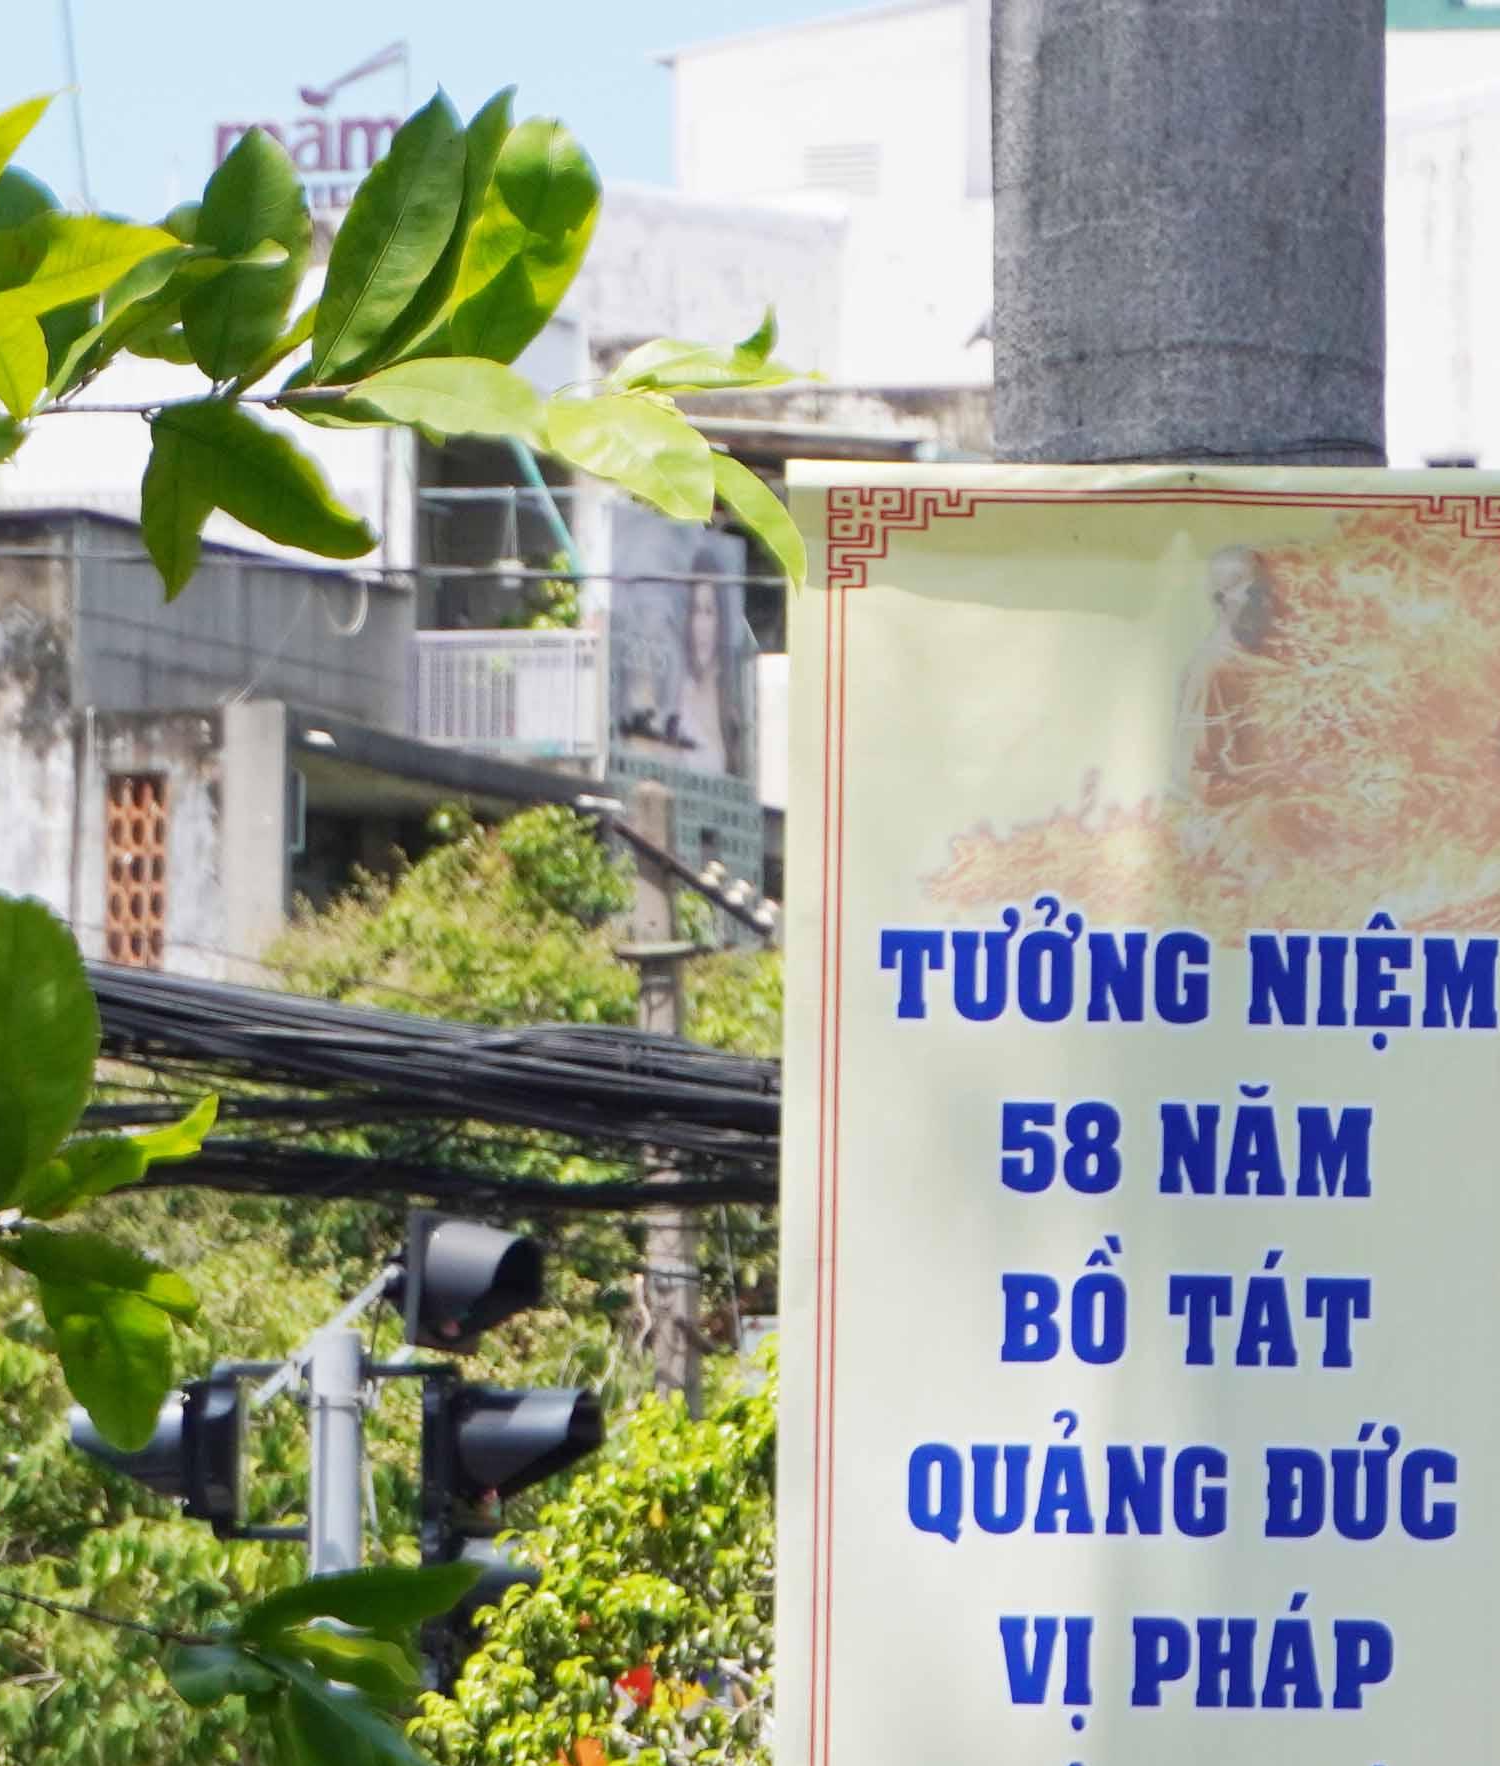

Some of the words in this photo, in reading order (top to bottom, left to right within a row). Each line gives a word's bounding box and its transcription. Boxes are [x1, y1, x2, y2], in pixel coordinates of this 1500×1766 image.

[880, 896, 1210, 1025] TƯỞNG
[1248, 911, 1499, 1051] NIỆM
[1001, 1101, 1122, 1194] 58
[1158, 1084, 1373, 1198] NĂM
[1001, 1235, 1127, 1365] BỒ
[1169, 1249, 1371, 1368] TÁT
[907, 1410, 1228, 1543] QUẢNG
[1264, 1422, 1457, 1541] ĐỨC
[999, 1617, 1093, 1730] VỊ
[1131, 1591, 1393, 1710] PHÁP
